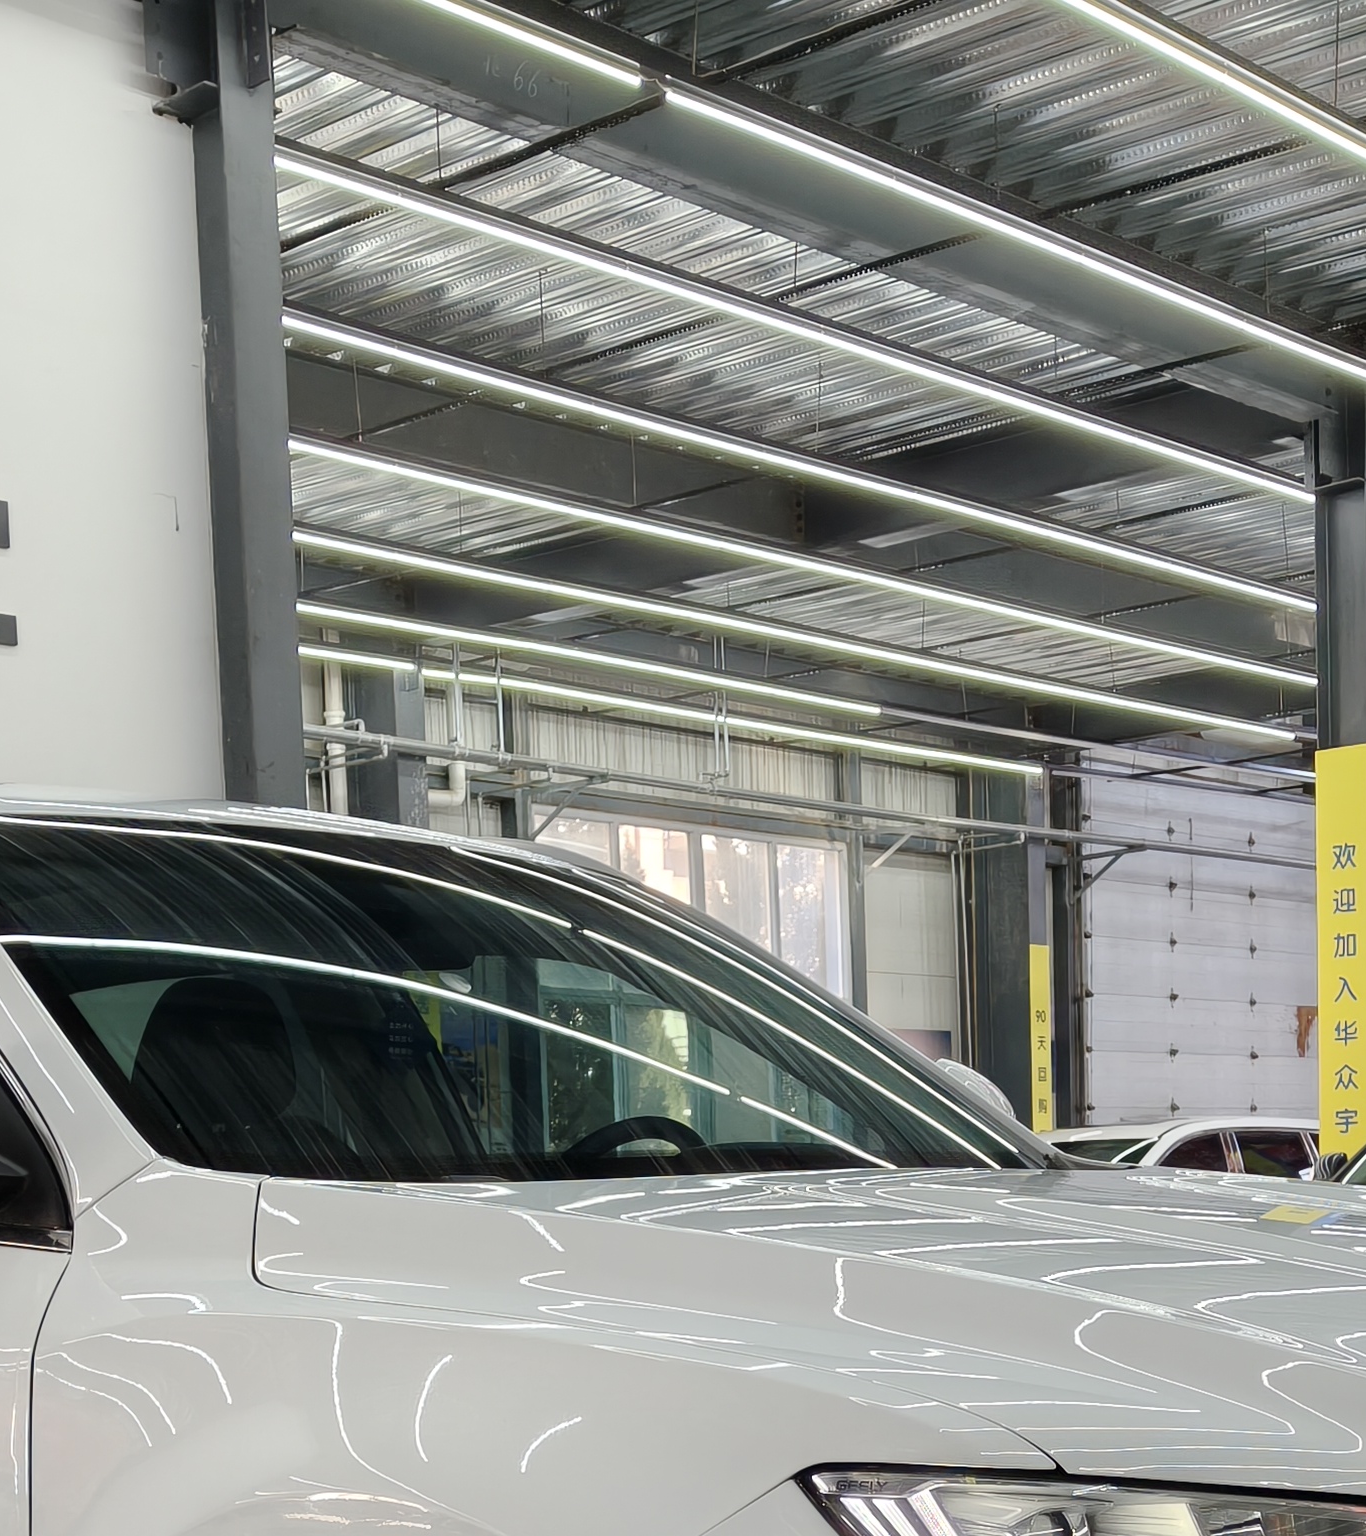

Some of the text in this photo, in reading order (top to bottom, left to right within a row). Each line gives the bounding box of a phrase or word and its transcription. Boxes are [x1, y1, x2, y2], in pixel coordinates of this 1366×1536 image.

[1035, 1010, 1047, 1114] 90天回购
[1332, 843, 1359, 1134] 欢迎加入华众宇
